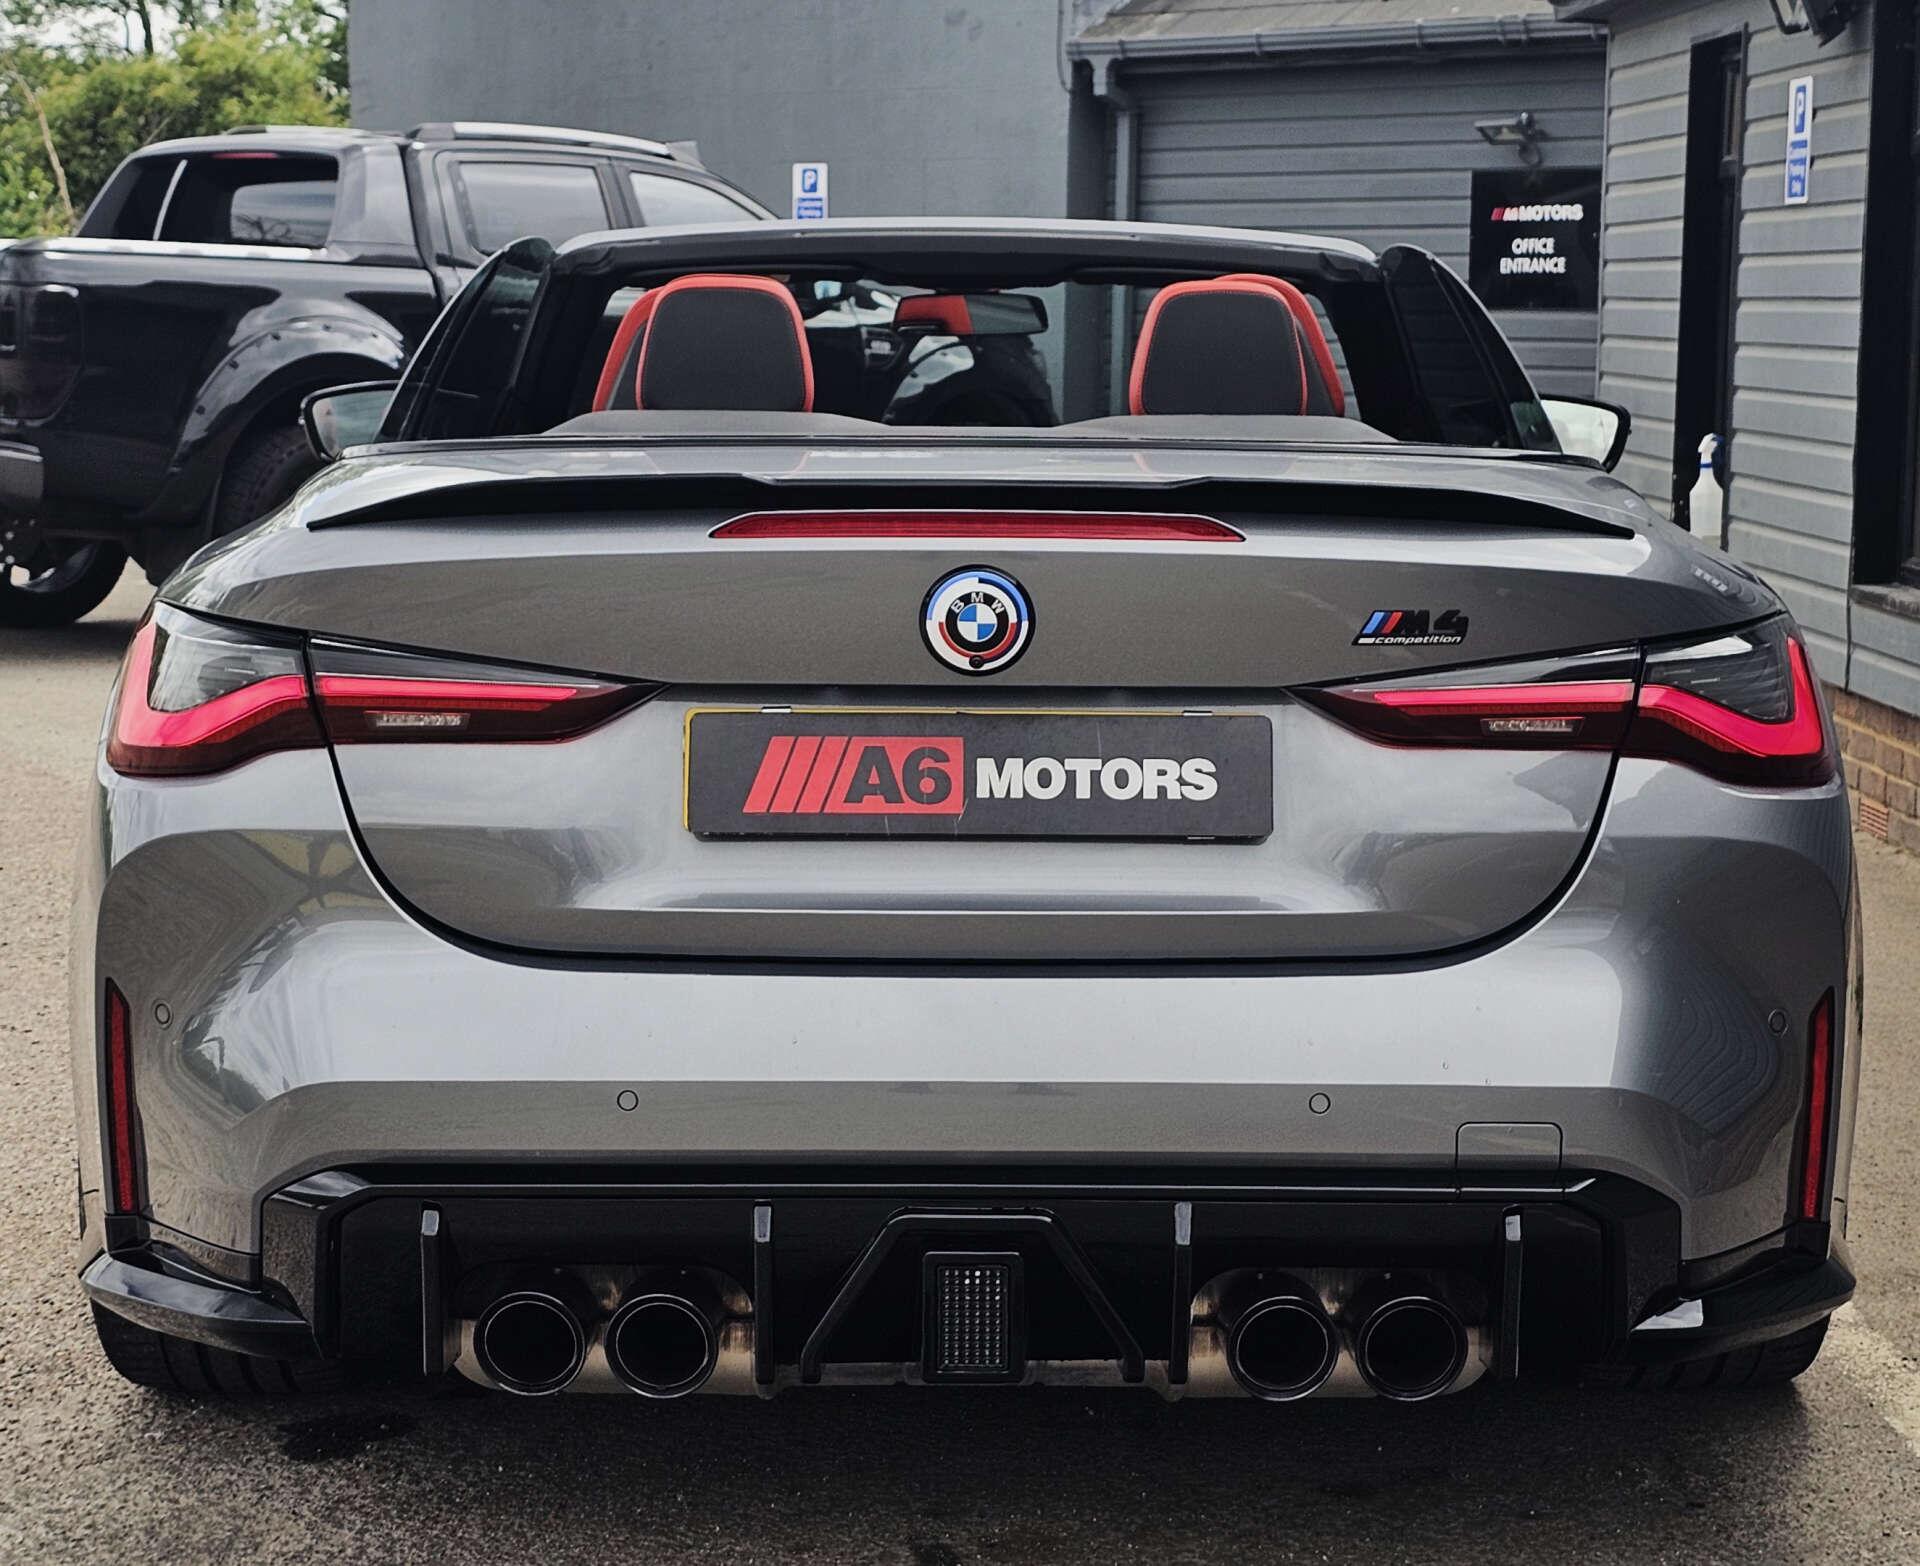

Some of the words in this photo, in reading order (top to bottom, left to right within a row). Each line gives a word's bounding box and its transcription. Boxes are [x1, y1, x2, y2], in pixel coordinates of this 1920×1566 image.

[804, 170, 817, 191] P
[1519, 204, 1584, 221] MOTORS
[1511, 237, 1555, 255] OFFICE
[1500, 257, 1566, 274] ENTRANCE
[950, 591, 1005, 614] BMW
[1395, 609, 1469, 637] M4
[1374, 635, 1462, 645] competition
[843, 745, 954, 805] A6
[975, 757, 1218, 801] MOTORS
